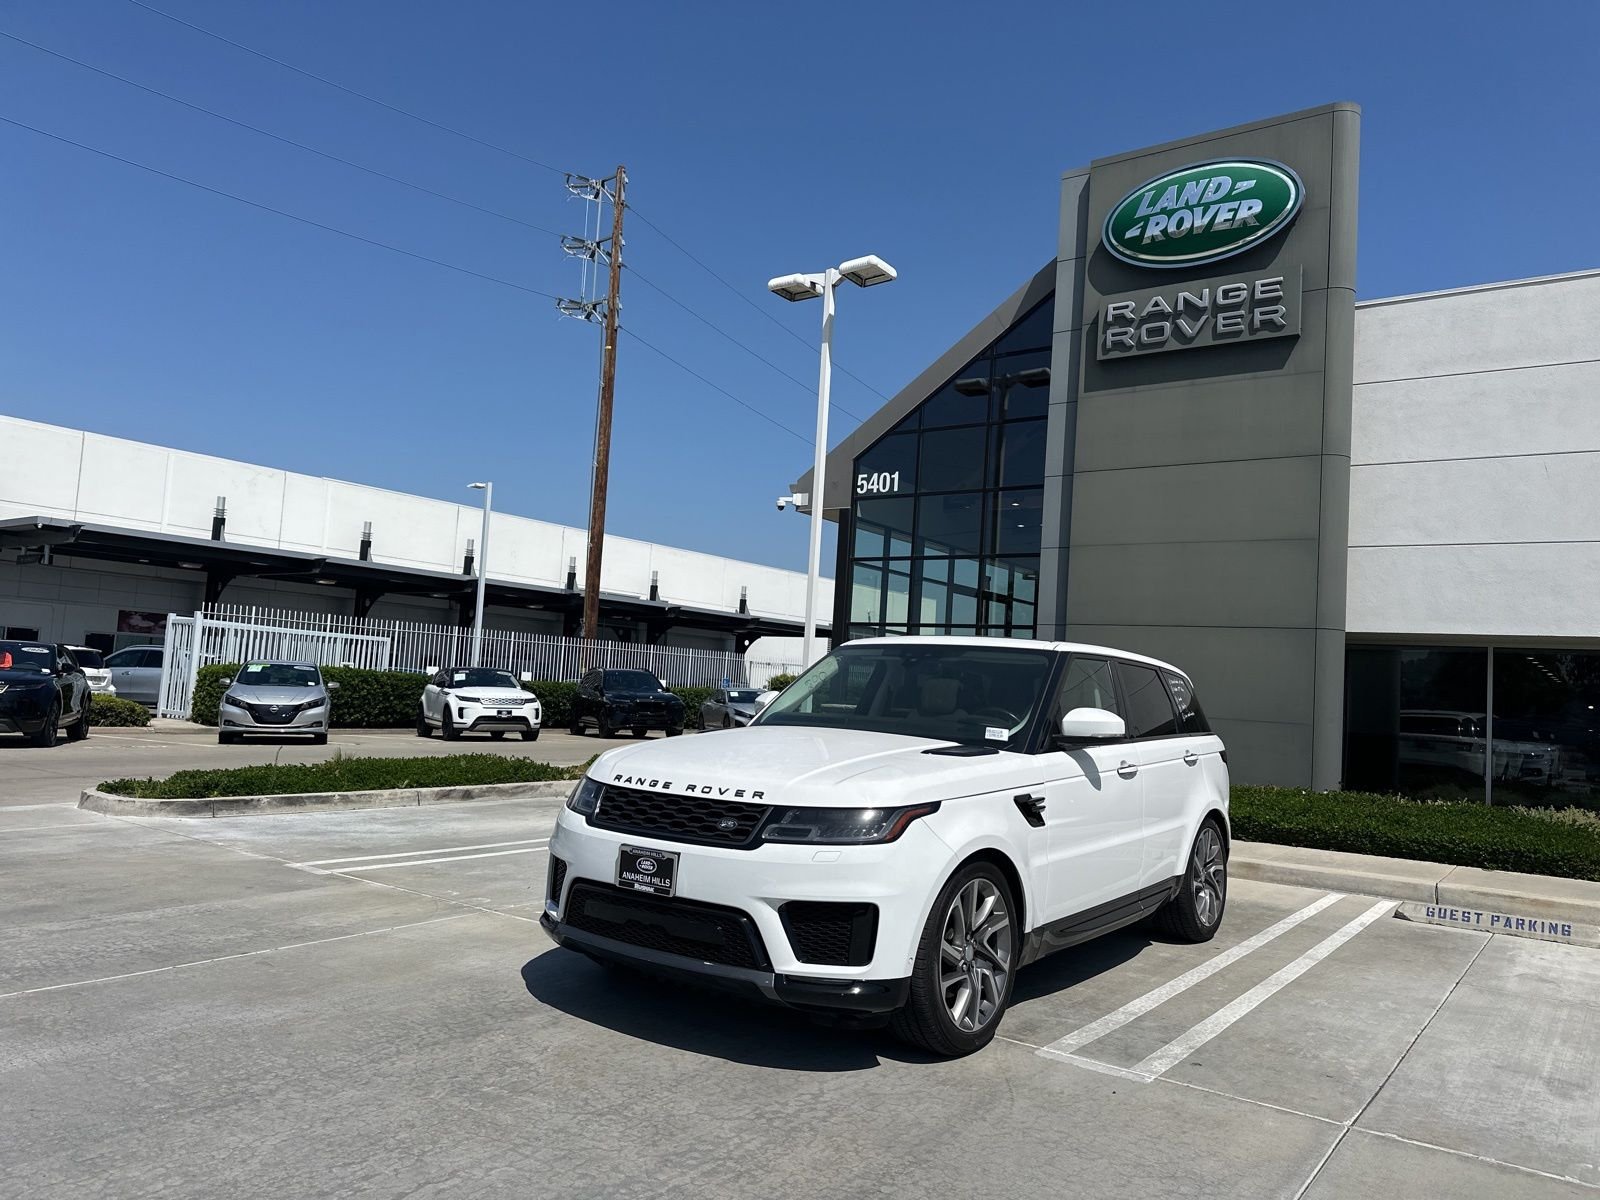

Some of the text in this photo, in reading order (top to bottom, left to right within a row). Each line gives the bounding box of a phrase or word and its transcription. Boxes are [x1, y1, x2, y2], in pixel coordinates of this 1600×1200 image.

[1135, 176, 1231, 218] LAND
[1142, 199, 1262, 244] ROVER
[1107, 276, 1284, 322] RANGE
[1106, 304, 1287, 349] ROVER
[857, 471, 899, 494] 5401
[613, 774, 764, 800] RANGE ROVER
[622, 871, 671, 887] ANAHEIM HILLS
[1426, 906, 1572, 936] GUEST PARKING
